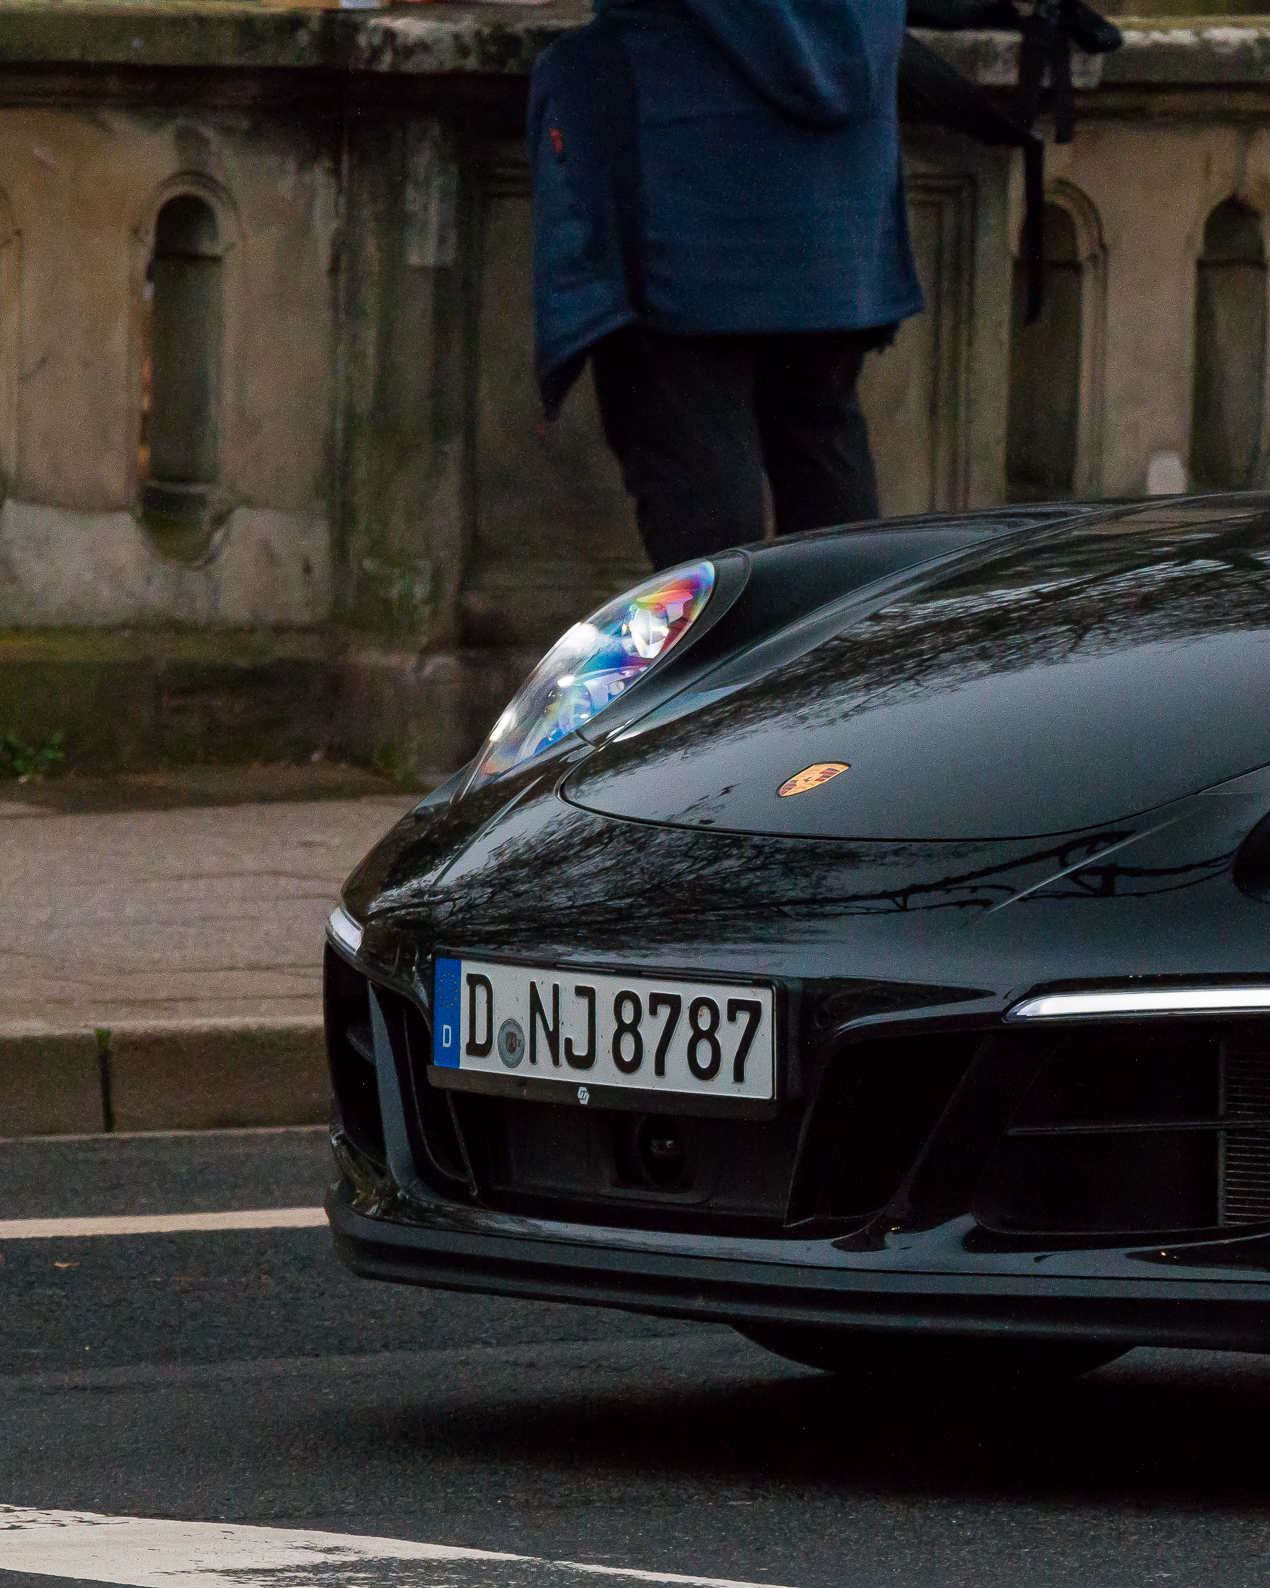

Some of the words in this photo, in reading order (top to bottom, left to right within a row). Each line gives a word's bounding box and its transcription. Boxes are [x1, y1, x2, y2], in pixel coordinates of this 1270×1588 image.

[442, 1024, 452, 1048] D
[465, 972, 494, 1057] D
[529, 980, 597, 1070] NJ
[611, 989, 763, 1084] 8787
